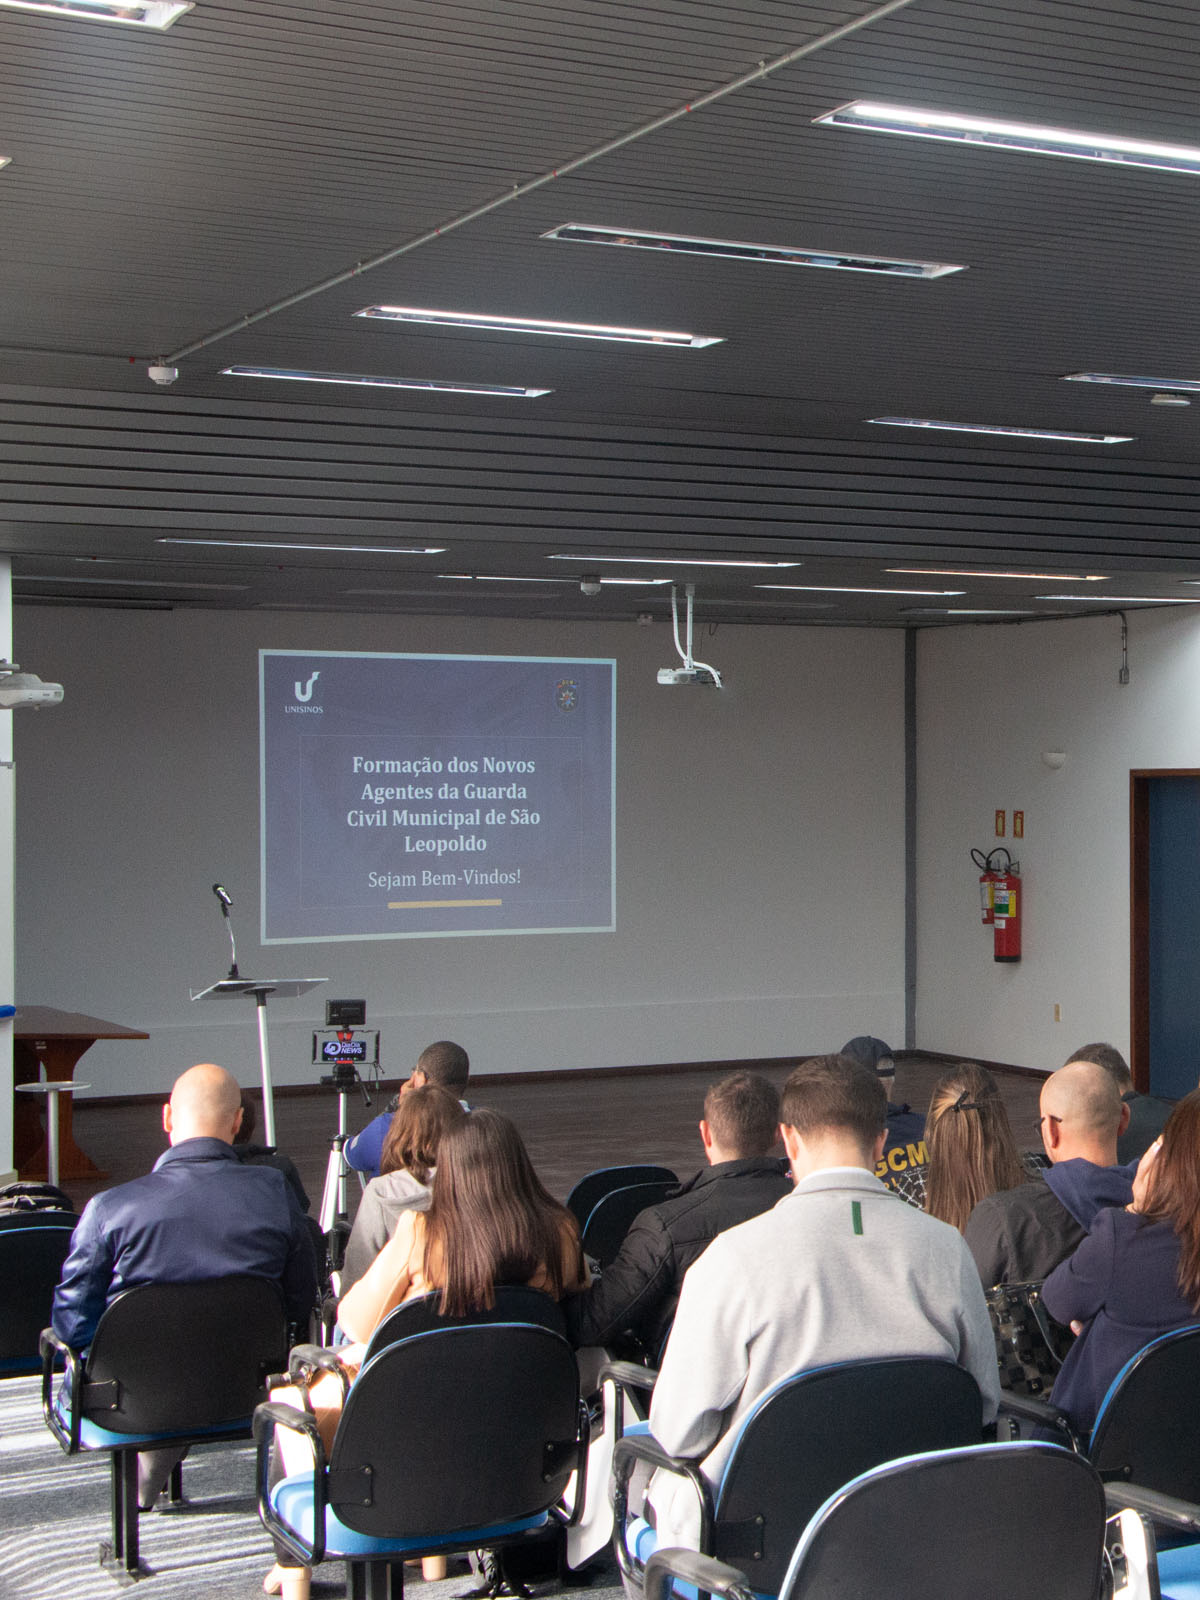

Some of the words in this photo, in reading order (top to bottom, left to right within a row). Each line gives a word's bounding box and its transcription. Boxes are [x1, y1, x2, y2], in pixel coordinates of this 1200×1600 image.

[284, 705, 324, 714] UNISINOS
[352, 756, 443, 777] Formação
[447, 756, 478, 773] dos
[483, 757, 536, 773] Novos
[361, 783, 433, 804] Agentes
[438, 783, 459, 800] da
[463, 783, 527, 799] Guarda
[347, 810, 387, 827] Civil
[392, 809, 481, 829] Municipal
[485, 809, 506, 825] de
[510, 809, 541, 825] São
[404, 835, 487, 856] Leopoldo
[368, 870, 416, 891] Sejam
[421, 868, 521, 886] Bem-Vindos!
